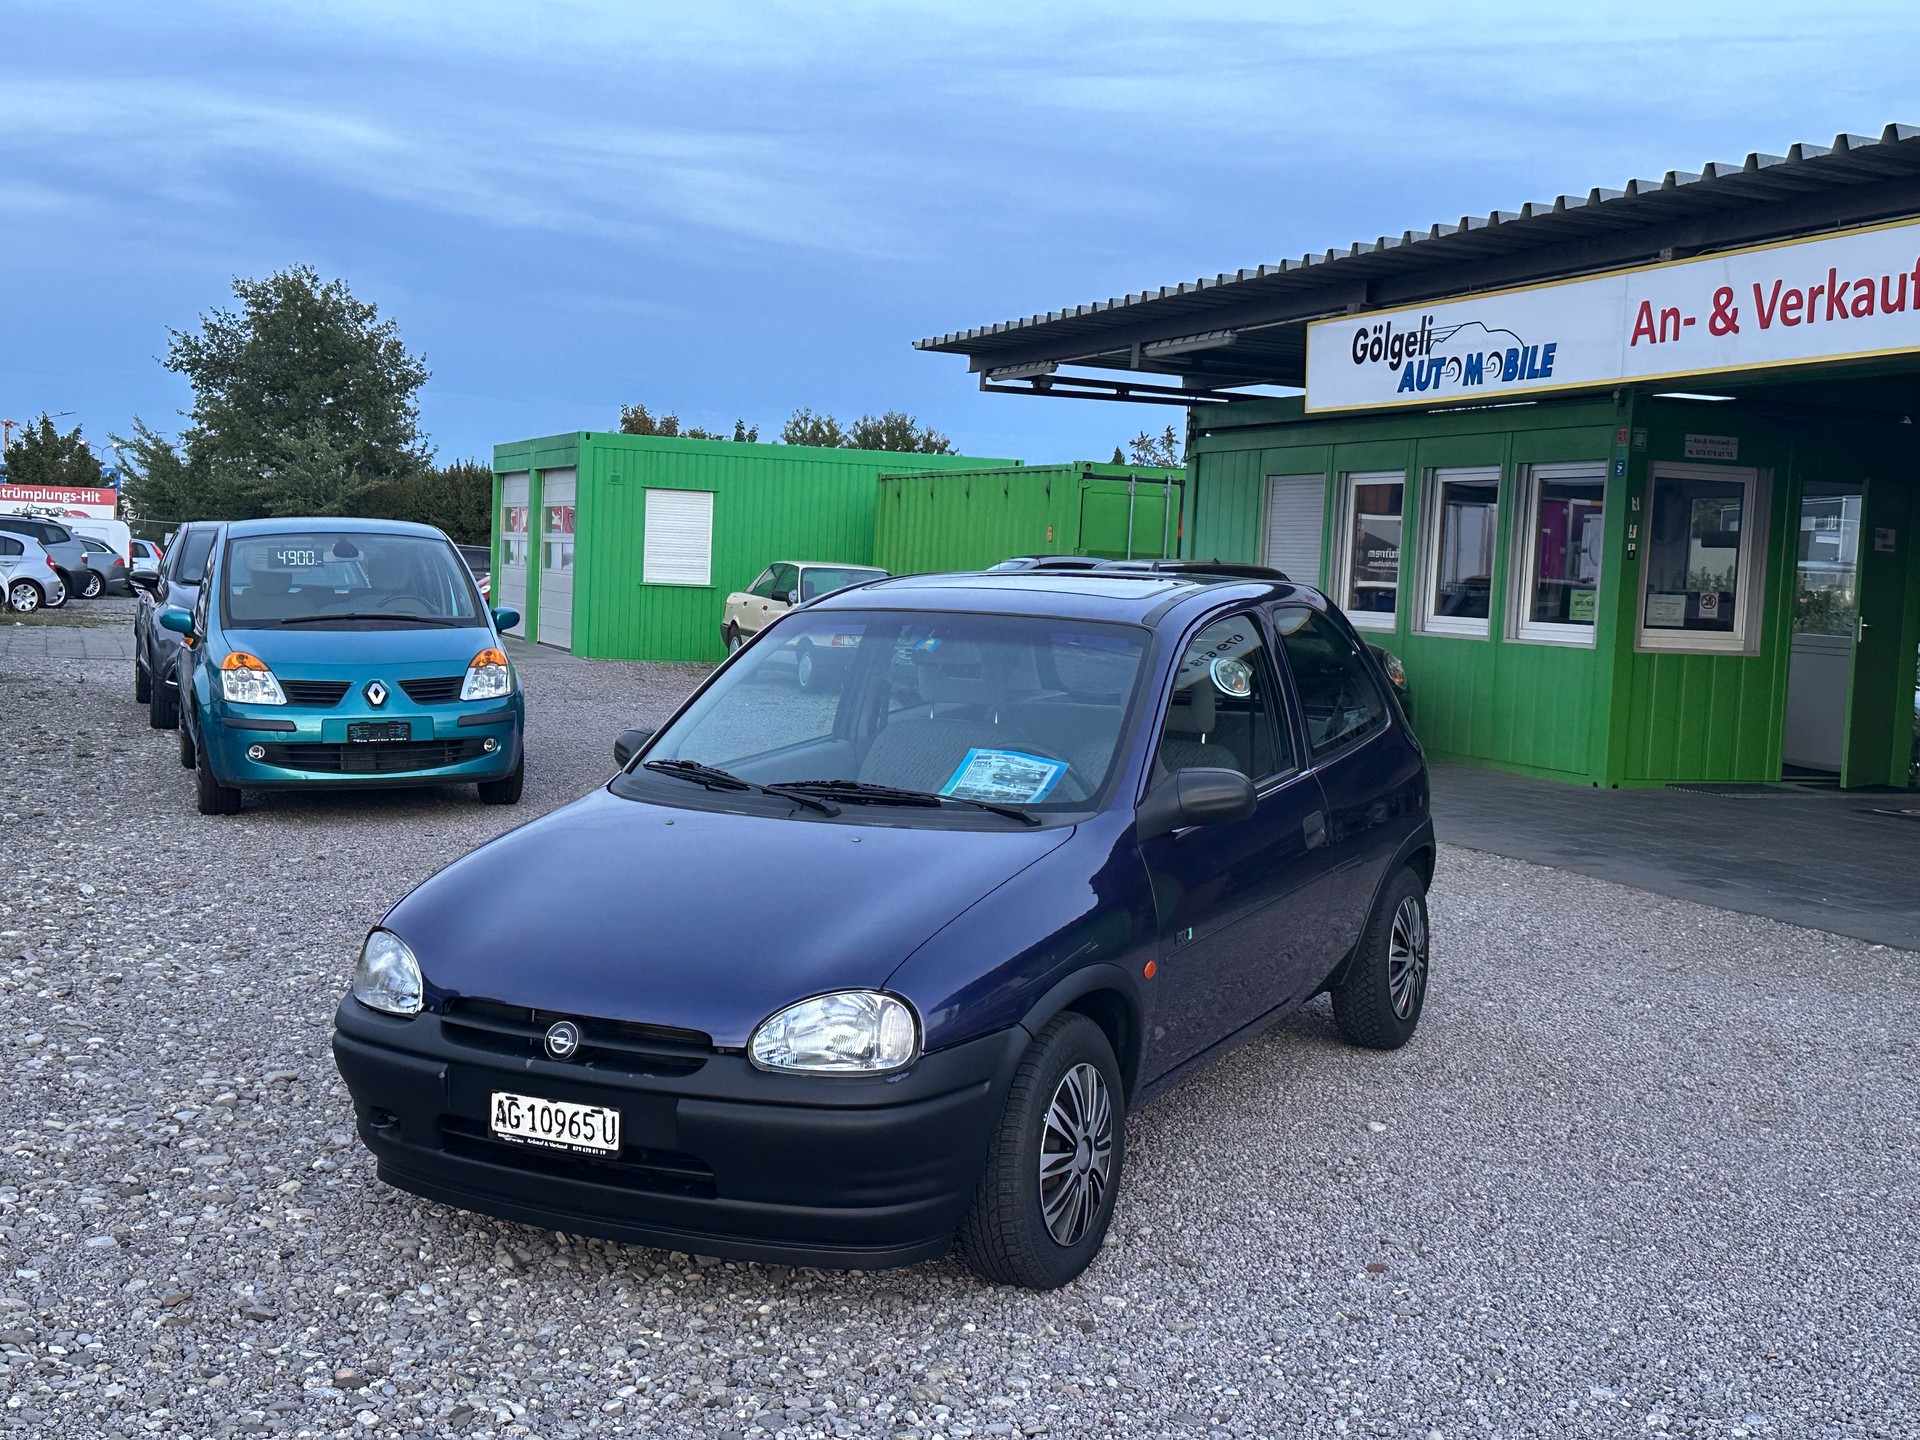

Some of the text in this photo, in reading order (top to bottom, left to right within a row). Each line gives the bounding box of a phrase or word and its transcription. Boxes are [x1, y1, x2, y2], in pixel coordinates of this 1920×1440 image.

[1352, 315, 1434, 371] Gölgeli
[1630, 300, 1696, 347] An-
[1708, 286, 1740, 337] &
[0, 487, 101, 504] trümplungs-Hit
